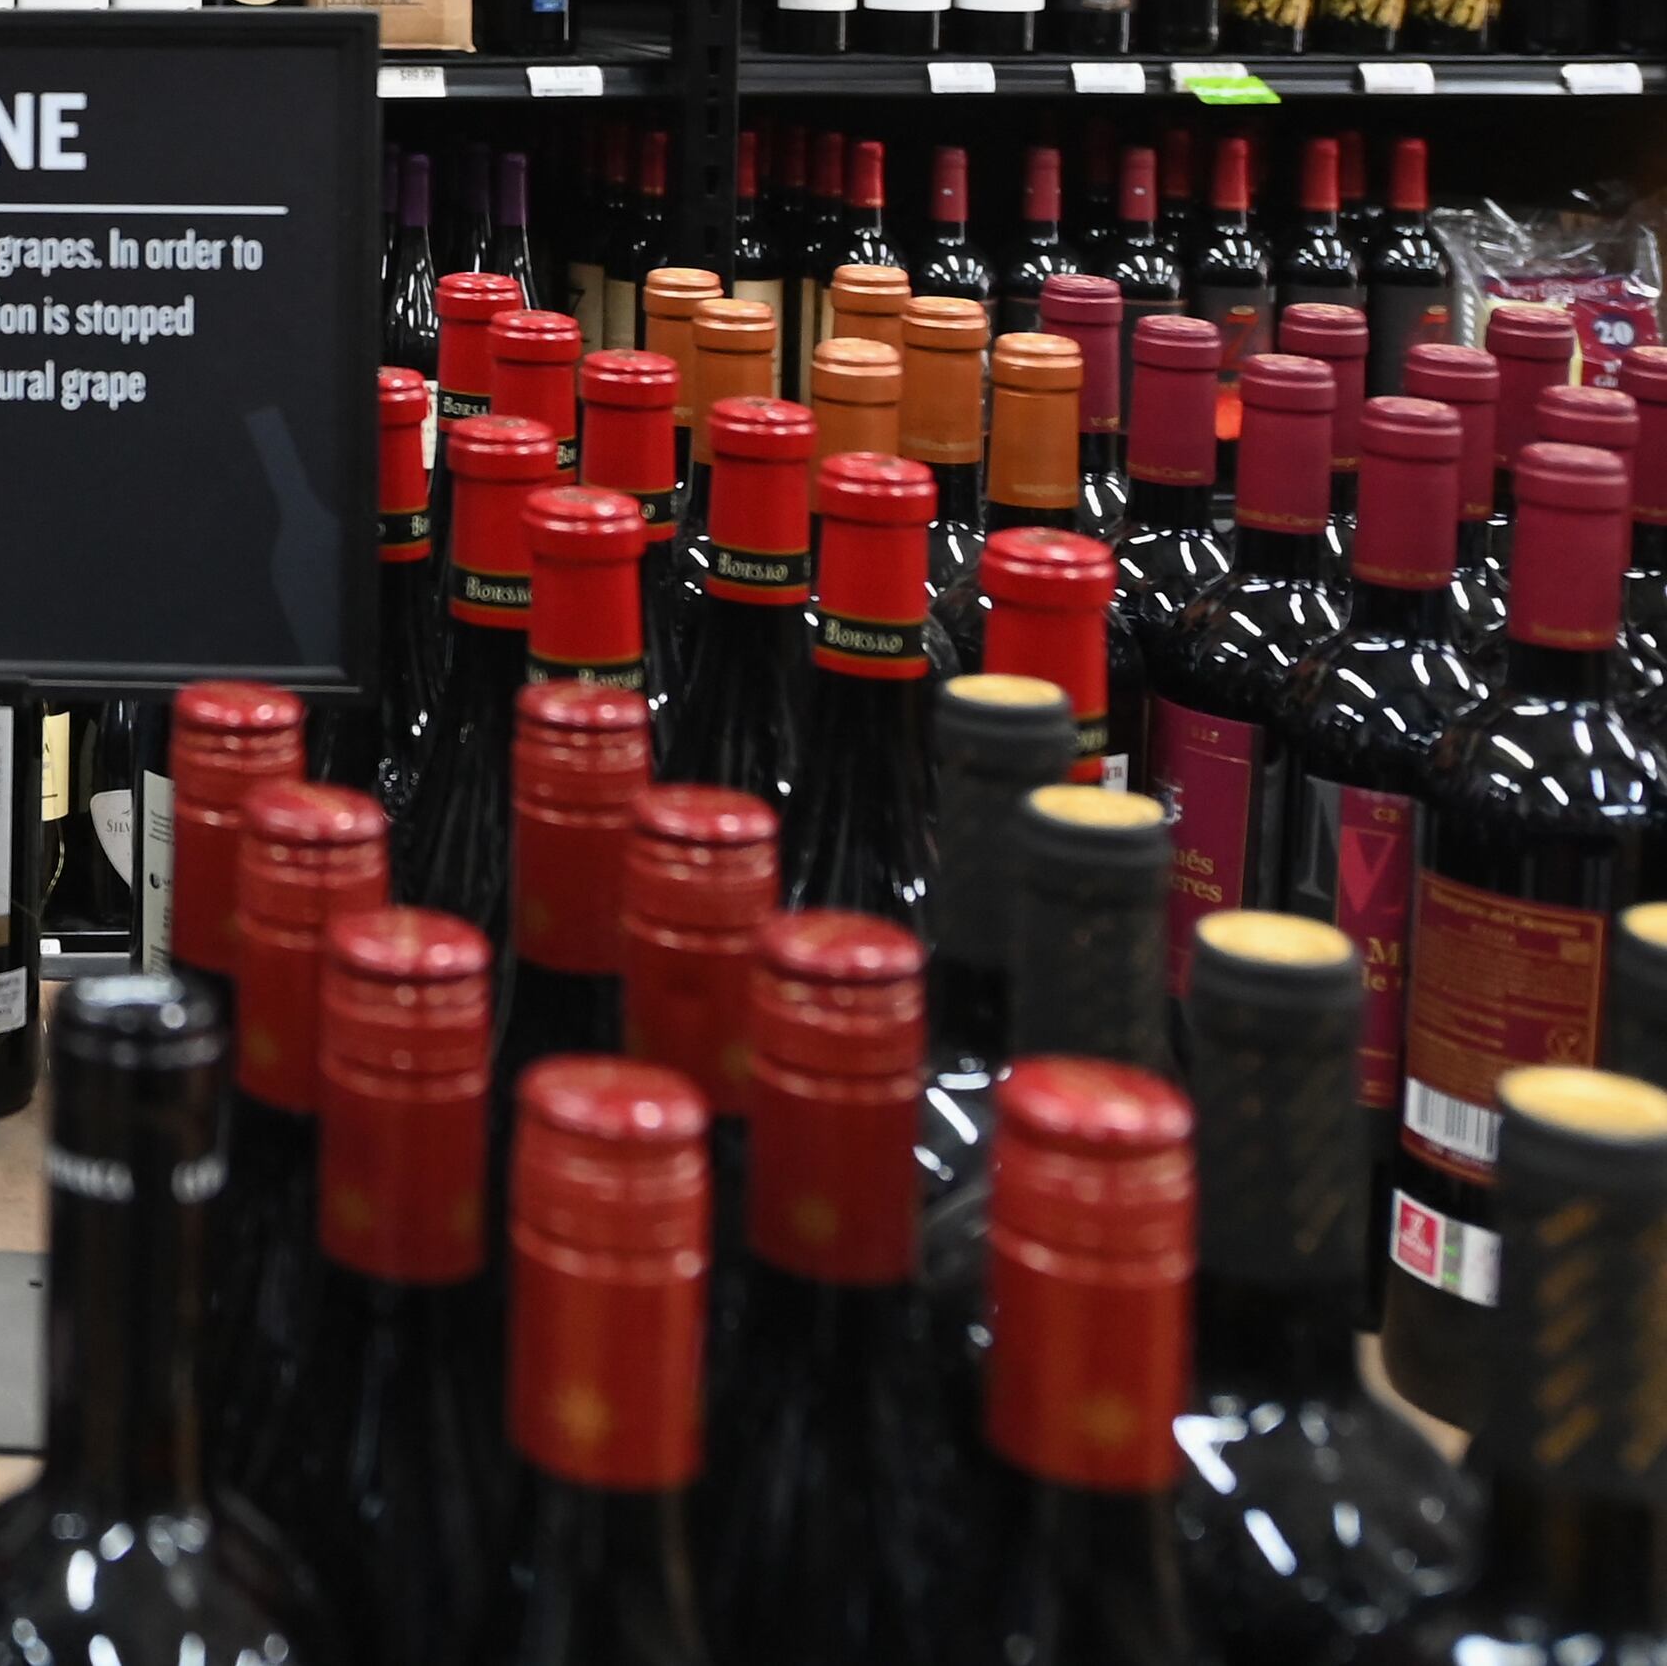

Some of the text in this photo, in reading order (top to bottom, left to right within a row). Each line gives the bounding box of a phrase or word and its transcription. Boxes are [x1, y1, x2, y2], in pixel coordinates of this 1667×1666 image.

[110, 230, 139, 271] In
[145, 231, 224, 271] order
[230, 234, 263, 271] to
[43, 294, 69, 334] is
[75, 295, 195, 343] stopped
[1595, 320, 1633, 347] 20
[61, 369, 147, 410] grape
[443, 396, 488, 416] BORSA
[718, 554, 789, 582] BORSAO
[825, 619, 904, 653] BORSAO
